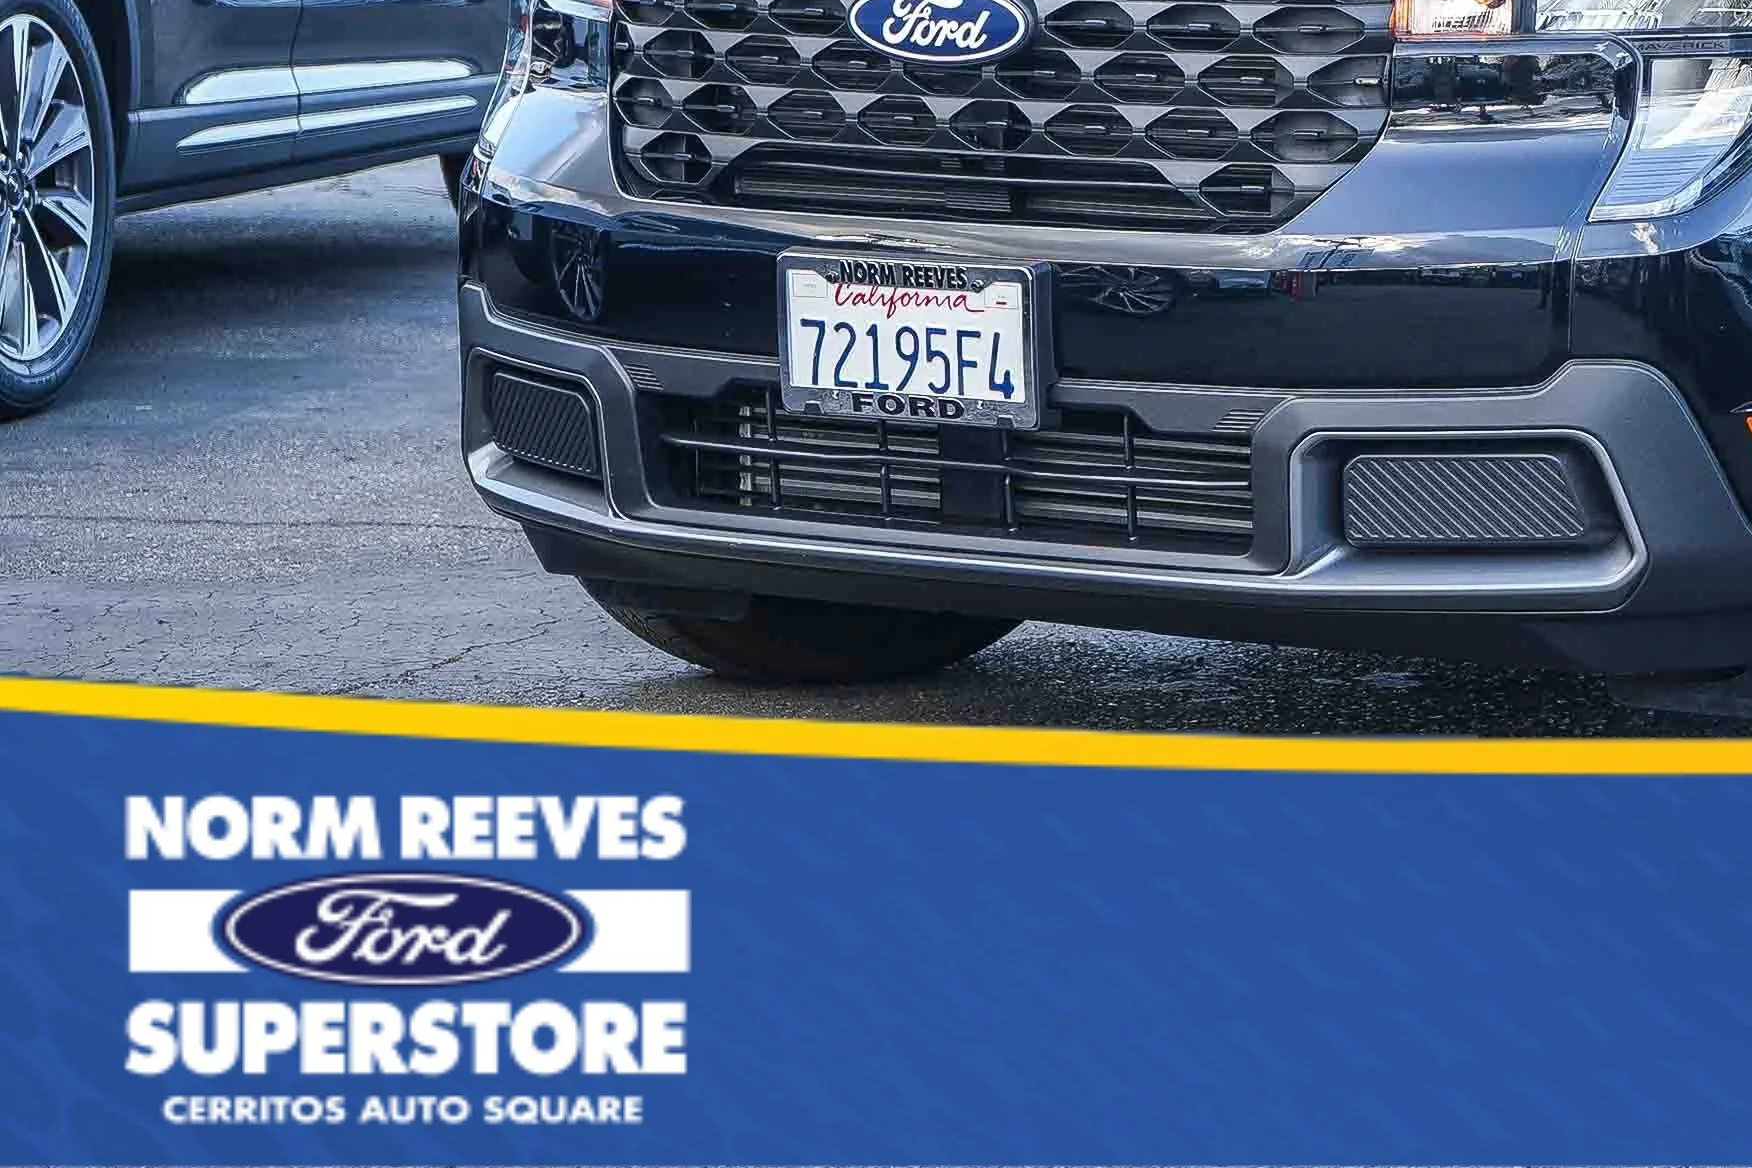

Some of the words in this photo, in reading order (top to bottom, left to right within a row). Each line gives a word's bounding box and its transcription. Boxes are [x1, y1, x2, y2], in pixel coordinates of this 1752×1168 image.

[840, 260, 895, 285] NORM
[903, 264, 968, 289] REEVES
[834, 282, 984, 319] California
[800, 318, 1015, 399] 72195F4
[852, 393, 965, 419] FORD
